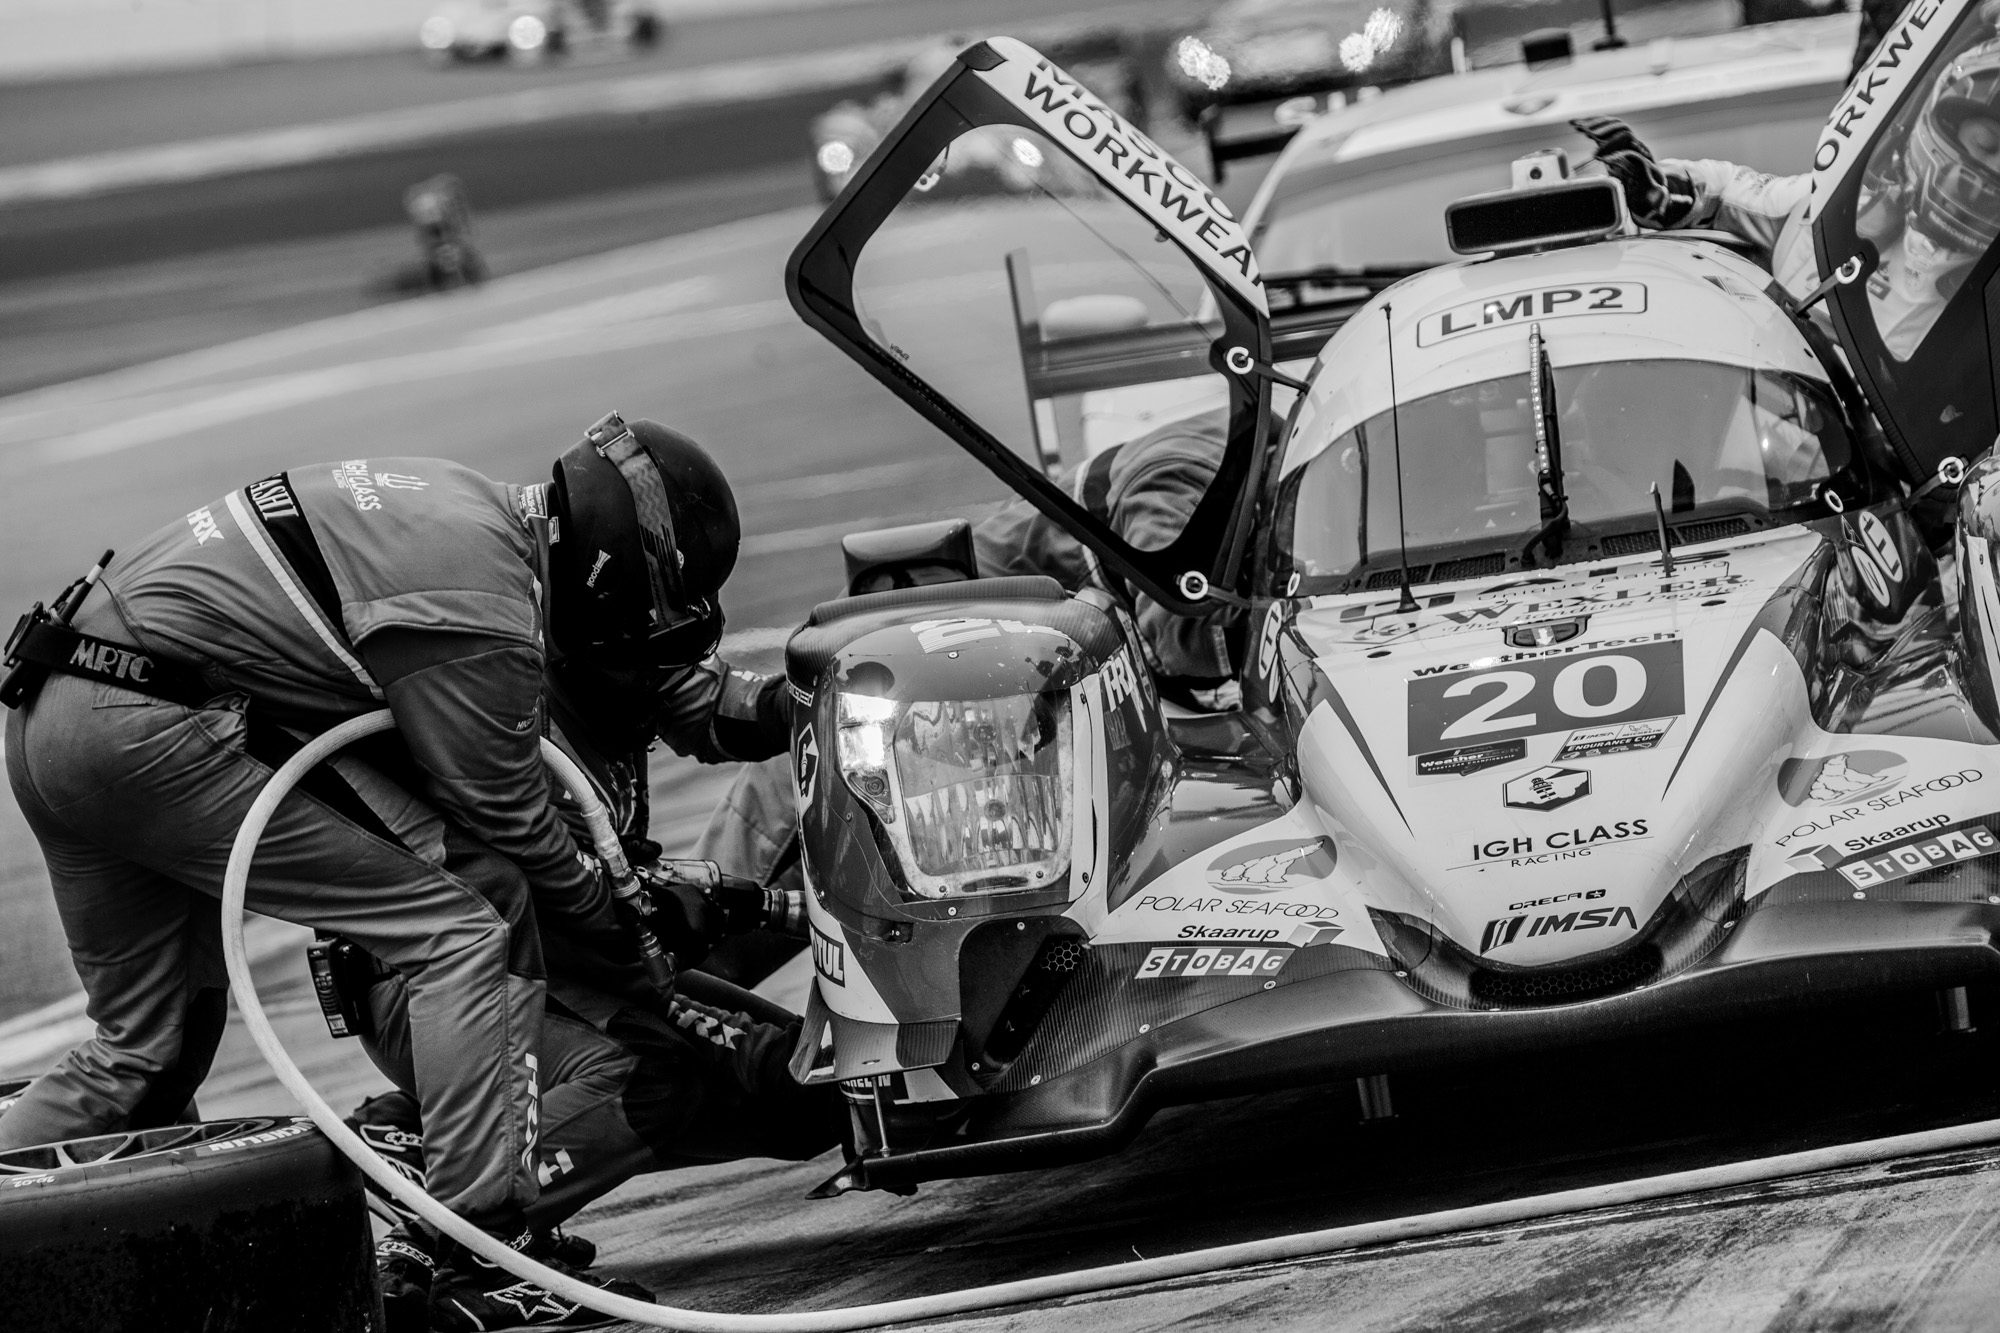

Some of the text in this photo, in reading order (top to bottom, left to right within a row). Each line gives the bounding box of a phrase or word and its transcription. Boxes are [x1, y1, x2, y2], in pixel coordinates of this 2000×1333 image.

[1024, 71, 1264, 287] WORKWEA
[1441, 286, 1623, 336] LMP2
[69, 639, 154, 682] MRTC
[1413, 633, 1676, 677] WetherTech
[1440, 654, 1648, 741] 20
[1775, 769, 1983, 847] POLAR SEAFOOD
[1473, 819, 1649, 861] IGH CLASS
[1844, 813, 1951, 852] Skaarup
[1510, 848, 1592, 867] RACING
[1852, 830, 1994, 881] STOBAG
[1135, 895, 1339, 919] POLAR SEAFOOD
[1508, 892, 1582, 911] ORECA
[1526, 906, 1638, 938] IMSA
[1177, 925, 1280, 943] Skaarup
[1144, 954, 1284, 973] STOBAG
